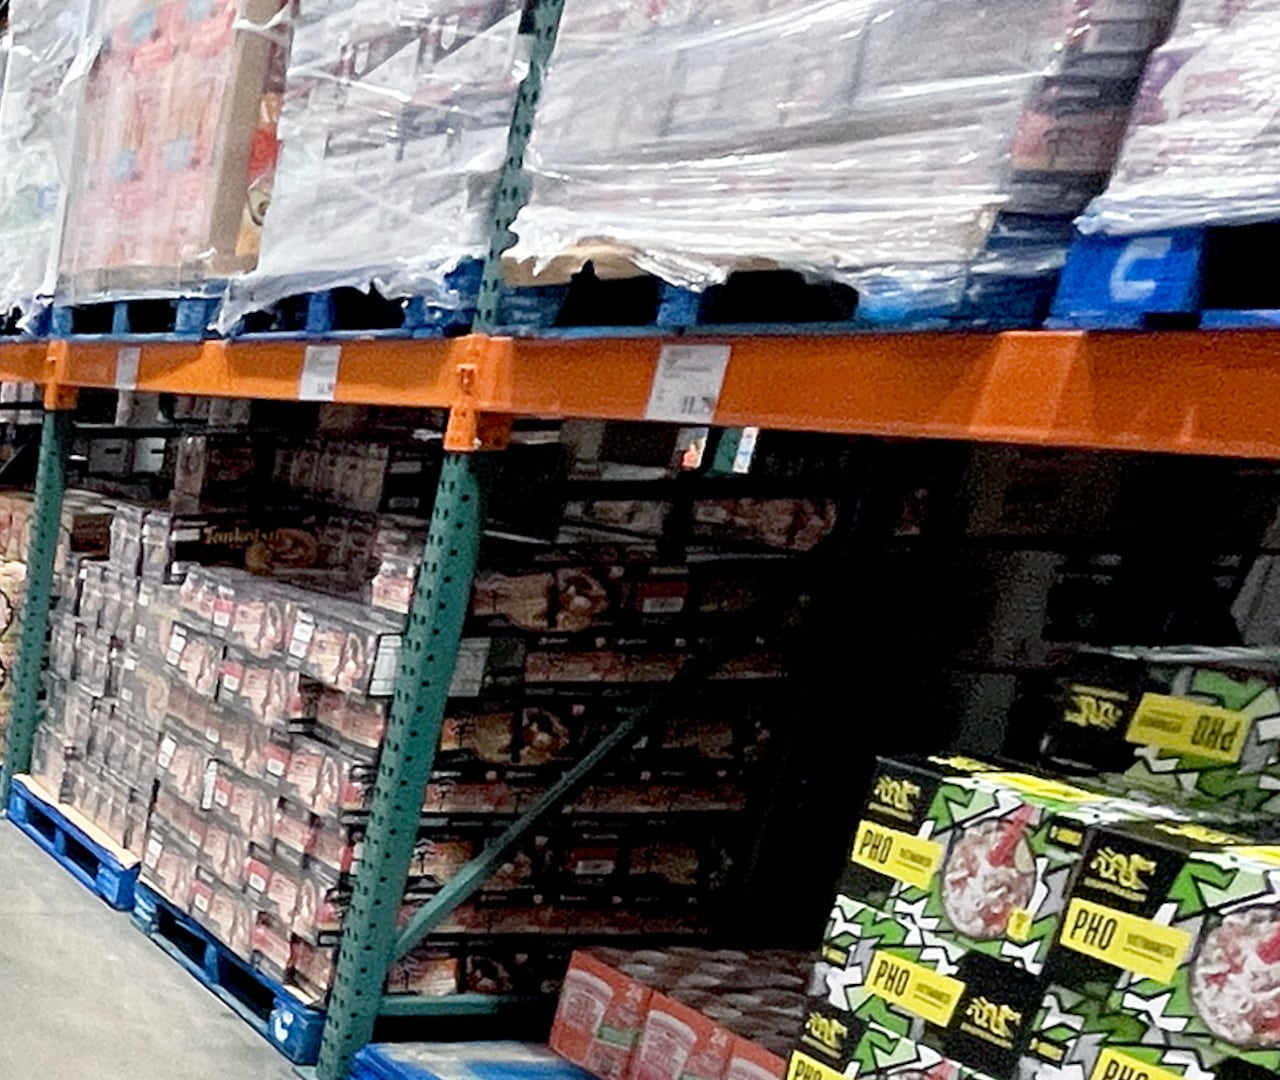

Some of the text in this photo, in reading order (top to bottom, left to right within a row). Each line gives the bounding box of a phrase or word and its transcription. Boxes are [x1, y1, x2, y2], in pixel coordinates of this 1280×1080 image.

[857, 829, 894, 865] PHO
[1069, 907, 1118, 951] PHO
[872, 959, 912, 997] PHO
